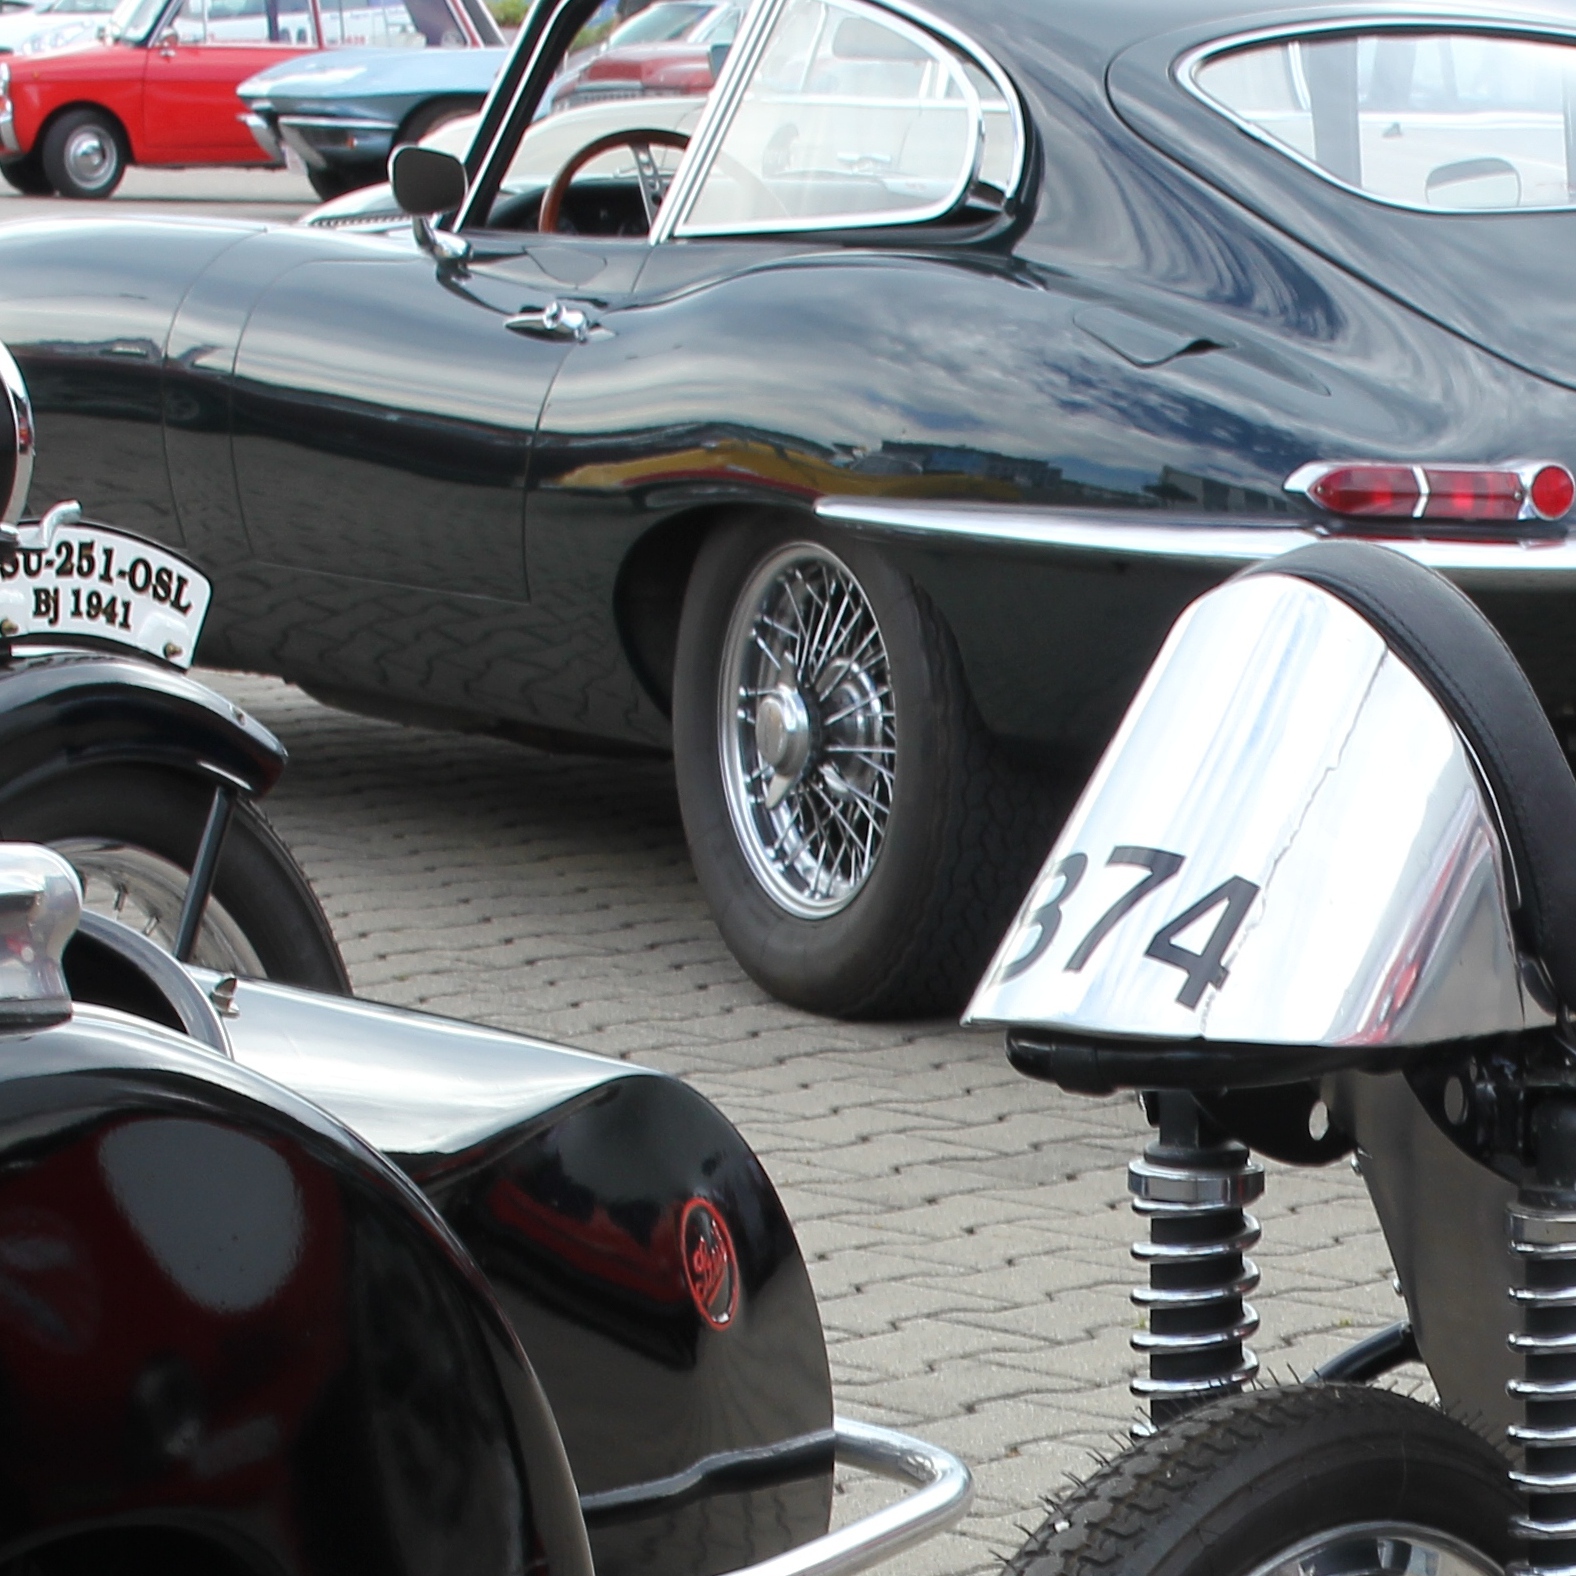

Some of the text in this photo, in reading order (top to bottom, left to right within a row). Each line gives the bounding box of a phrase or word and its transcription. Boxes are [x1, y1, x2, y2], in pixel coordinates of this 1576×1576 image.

[33, 587, 132, 631] Bj 1941
[998, 845, 1260, 1012] 374
